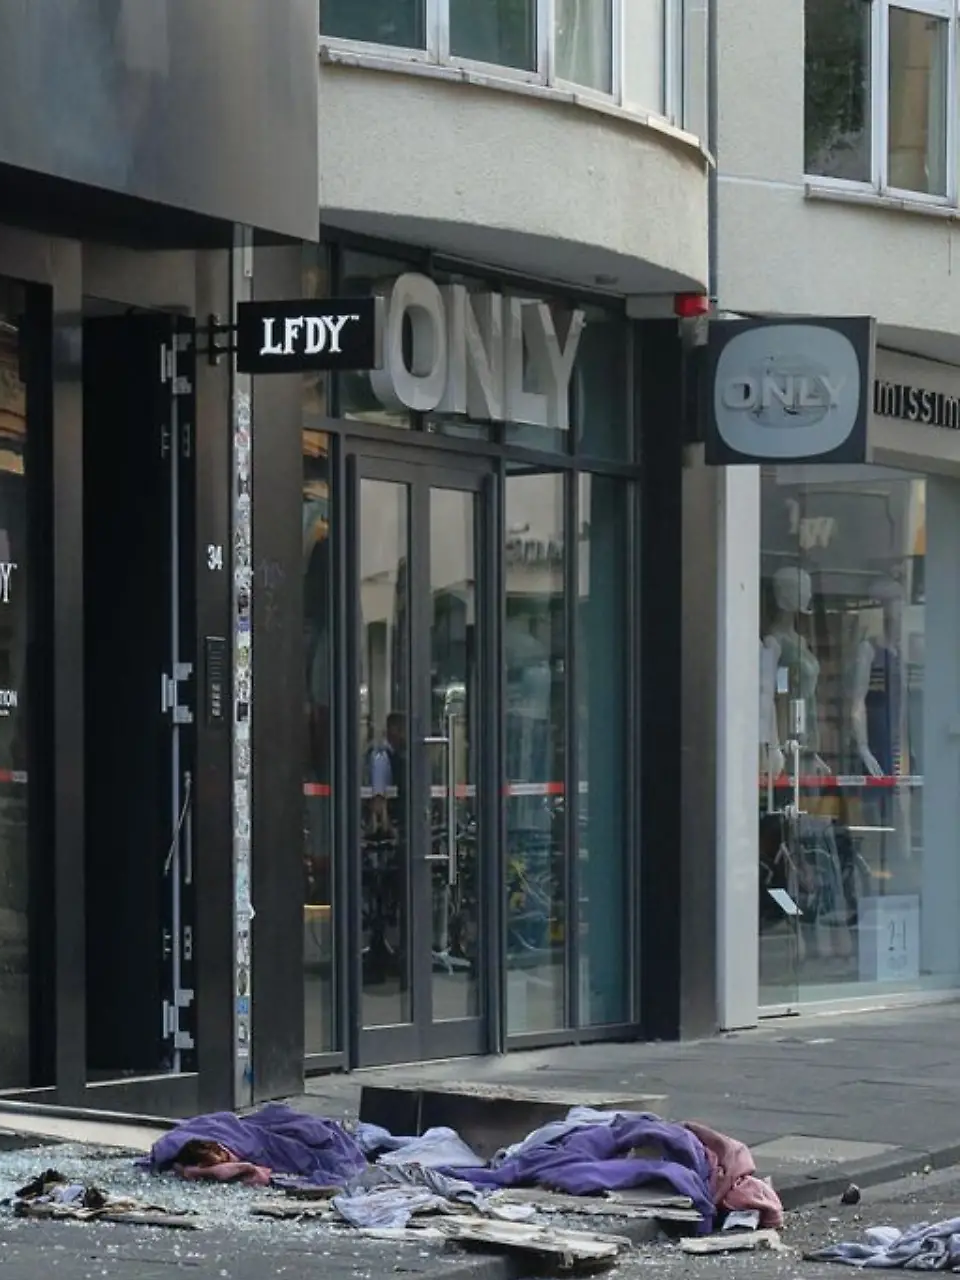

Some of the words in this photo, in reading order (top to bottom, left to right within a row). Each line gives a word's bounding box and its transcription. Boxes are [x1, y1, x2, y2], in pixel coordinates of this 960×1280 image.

[371, 272, 586, 430] ONLY
[722, 373, 846, 412] ONLY
[207, 545, 223, 570] 34
